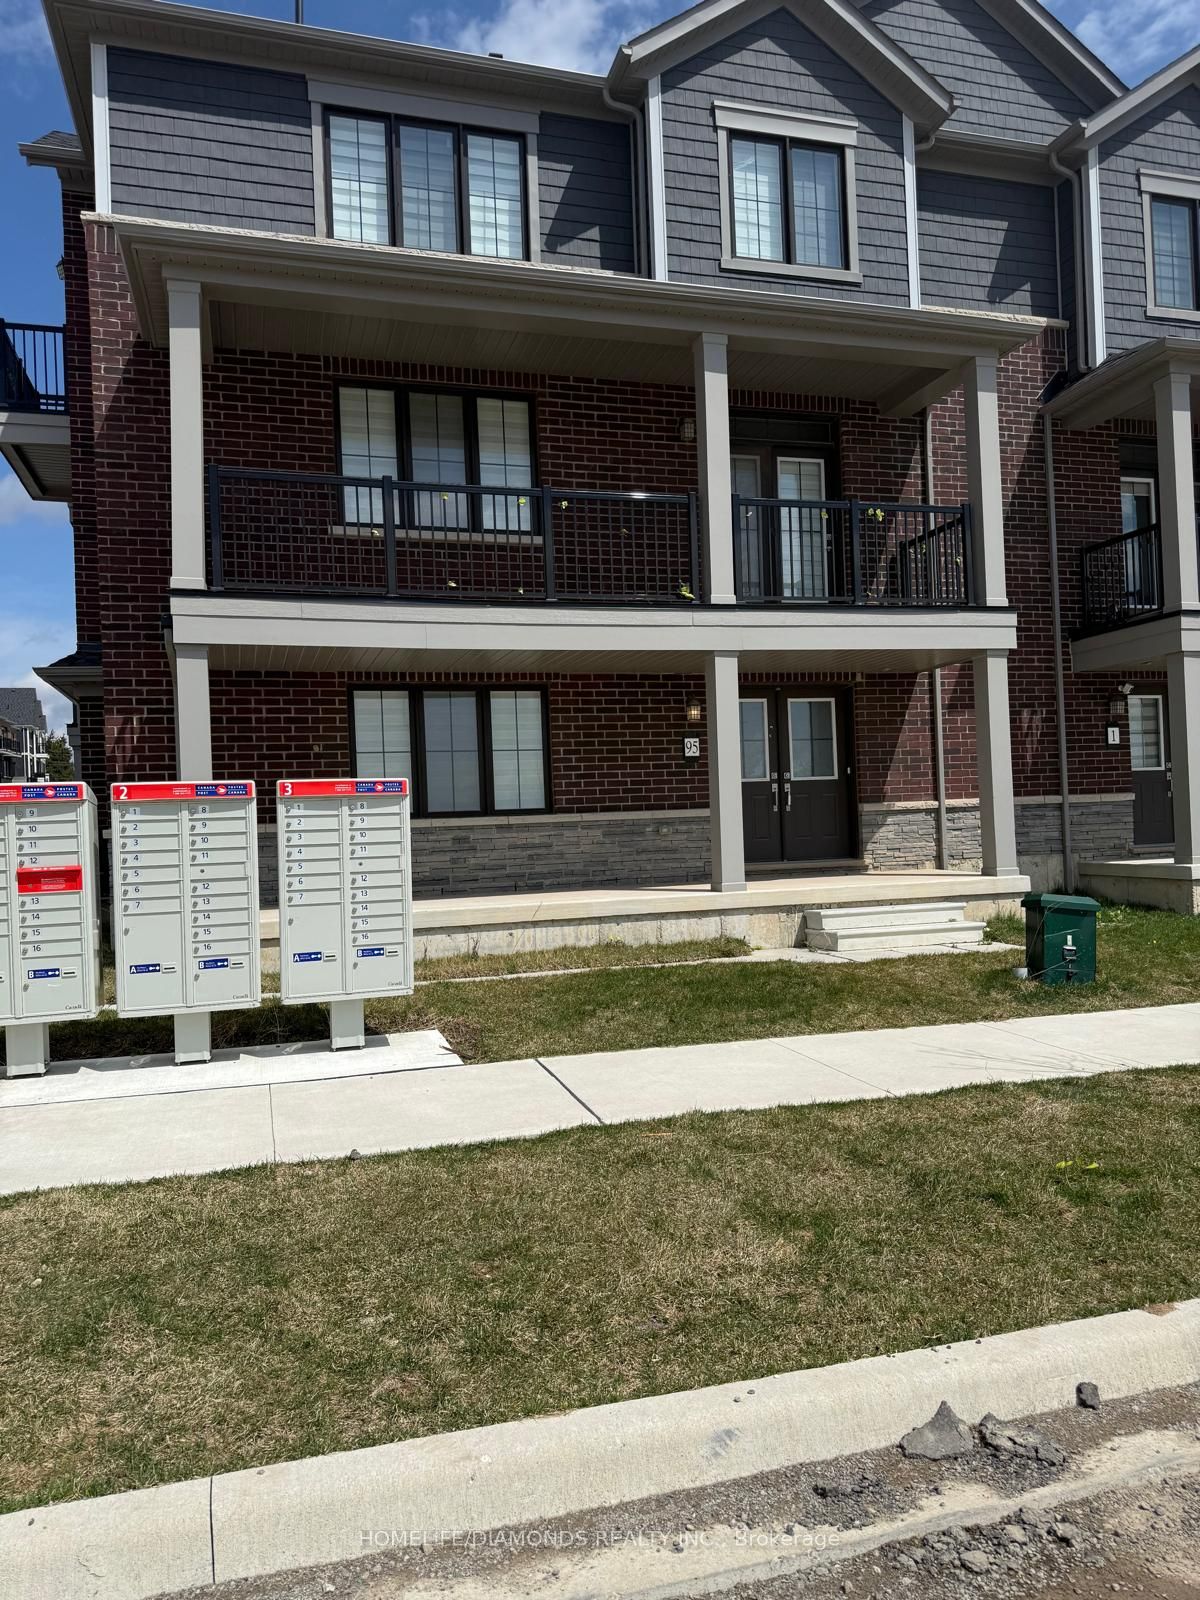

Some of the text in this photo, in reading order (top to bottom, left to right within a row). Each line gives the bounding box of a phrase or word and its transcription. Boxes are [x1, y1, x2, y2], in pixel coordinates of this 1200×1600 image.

[1111, 729, 1116, 742] 1
[686, 740, 699, 755] 95
[119, 786, 129, 800] 2
[283, 782, 293, 796] 3
[201, 806, 207, 814] 8
[359, 802, 365, 810] 8
[28, 809, 35, 817] 9
[201, 821, 207, 829] 9
[297, 818, 302, 826] 2
[28, 825, 37, 833] 10
[132, 823, 138, 831] 2
[200, 836, 209, 844] 10
[297, 833, 302, 841] 3
[29, 841, 37, 849] 11
[133, 838, 139, 846] 3
[29, 856, 38, 864] 12
[297, 862, 303, 870] 5
[134, 869, 140, 877] 5
[298, 877, 304, 885] 6
[360, 874, 368, 882] 12
[202, 882, 210, 890] 12
[299, 892, 304, 900] 7
[360, 889, 368, 897] 13
[31, 897, 40, 905] 13
[135, 901, 141, 909] 7
[202, 897, 211, 905] 13
[31, 913, 41, 921] 14
[361, 918, 369, 926] 15
[31, 928, 41, 936] 15
[32, 944, 42, 952] 16
[203, 943, 212, 951] 16
[292, 954, 300, 962] A
[199, 961, 205, 969] B
[29, 970, 34, 978] B
[130, 966, 137, 974] A
